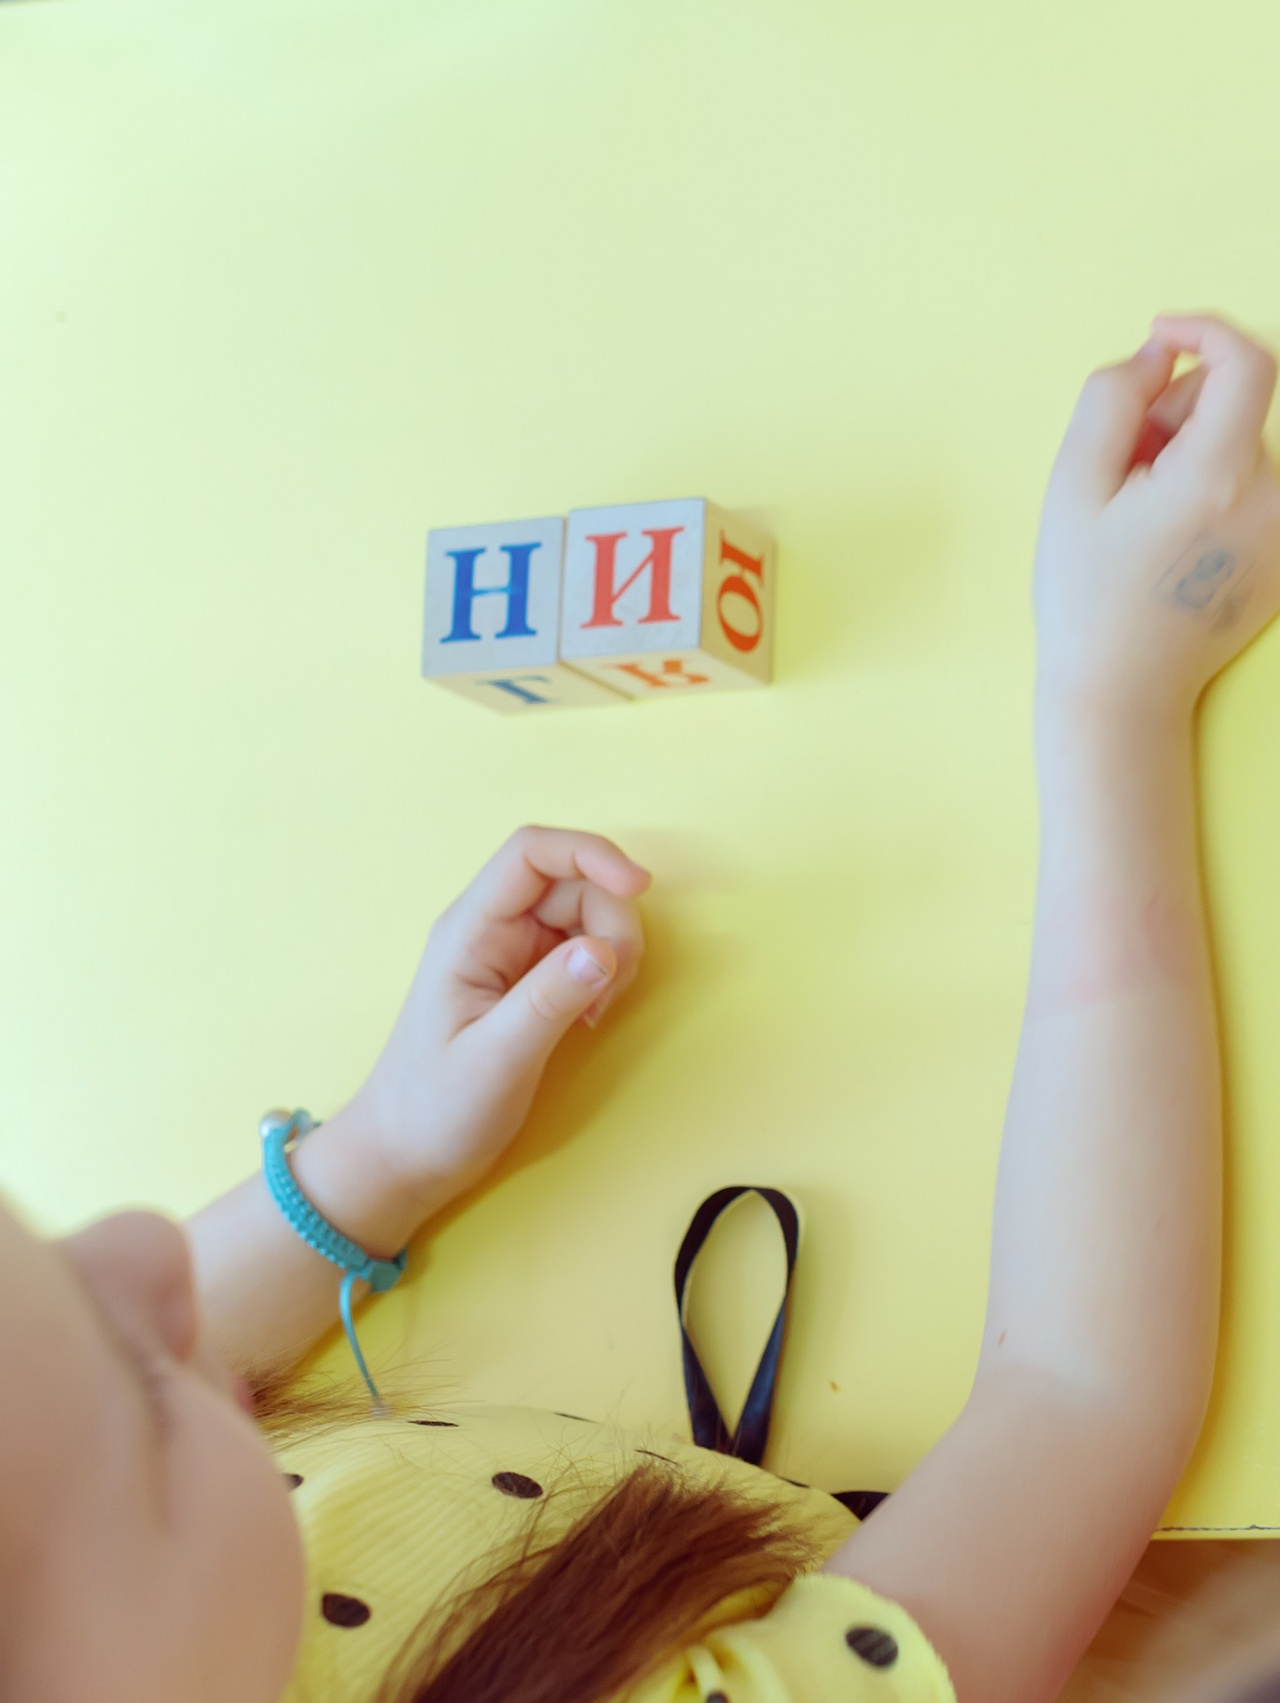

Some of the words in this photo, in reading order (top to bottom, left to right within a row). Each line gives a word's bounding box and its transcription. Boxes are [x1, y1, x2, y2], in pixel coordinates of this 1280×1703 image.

[440, 541, 542, 644] Н
[580, 526, 685, 630] И
[716, 528, 765, 653] Ю
